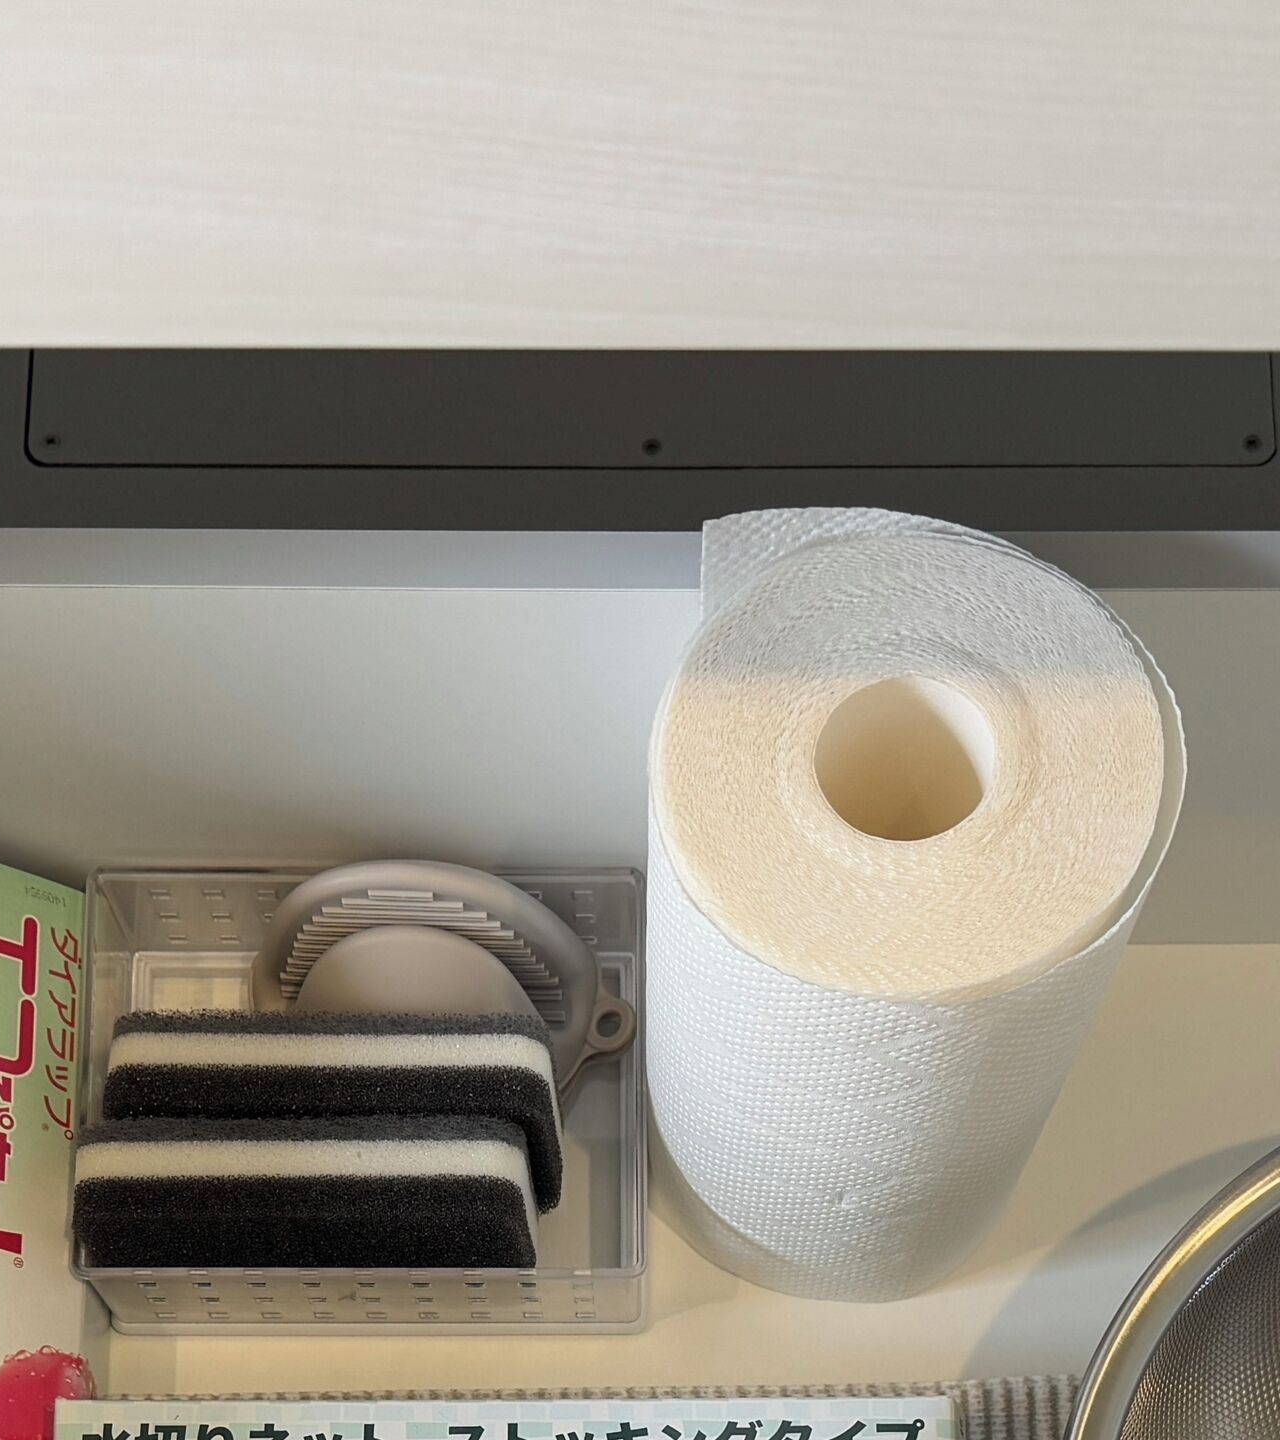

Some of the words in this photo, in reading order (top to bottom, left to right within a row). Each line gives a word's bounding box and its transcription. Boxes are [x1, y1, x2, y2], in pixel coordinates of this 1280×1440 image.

[43, 926, 87, 1141] ダイアラップ
